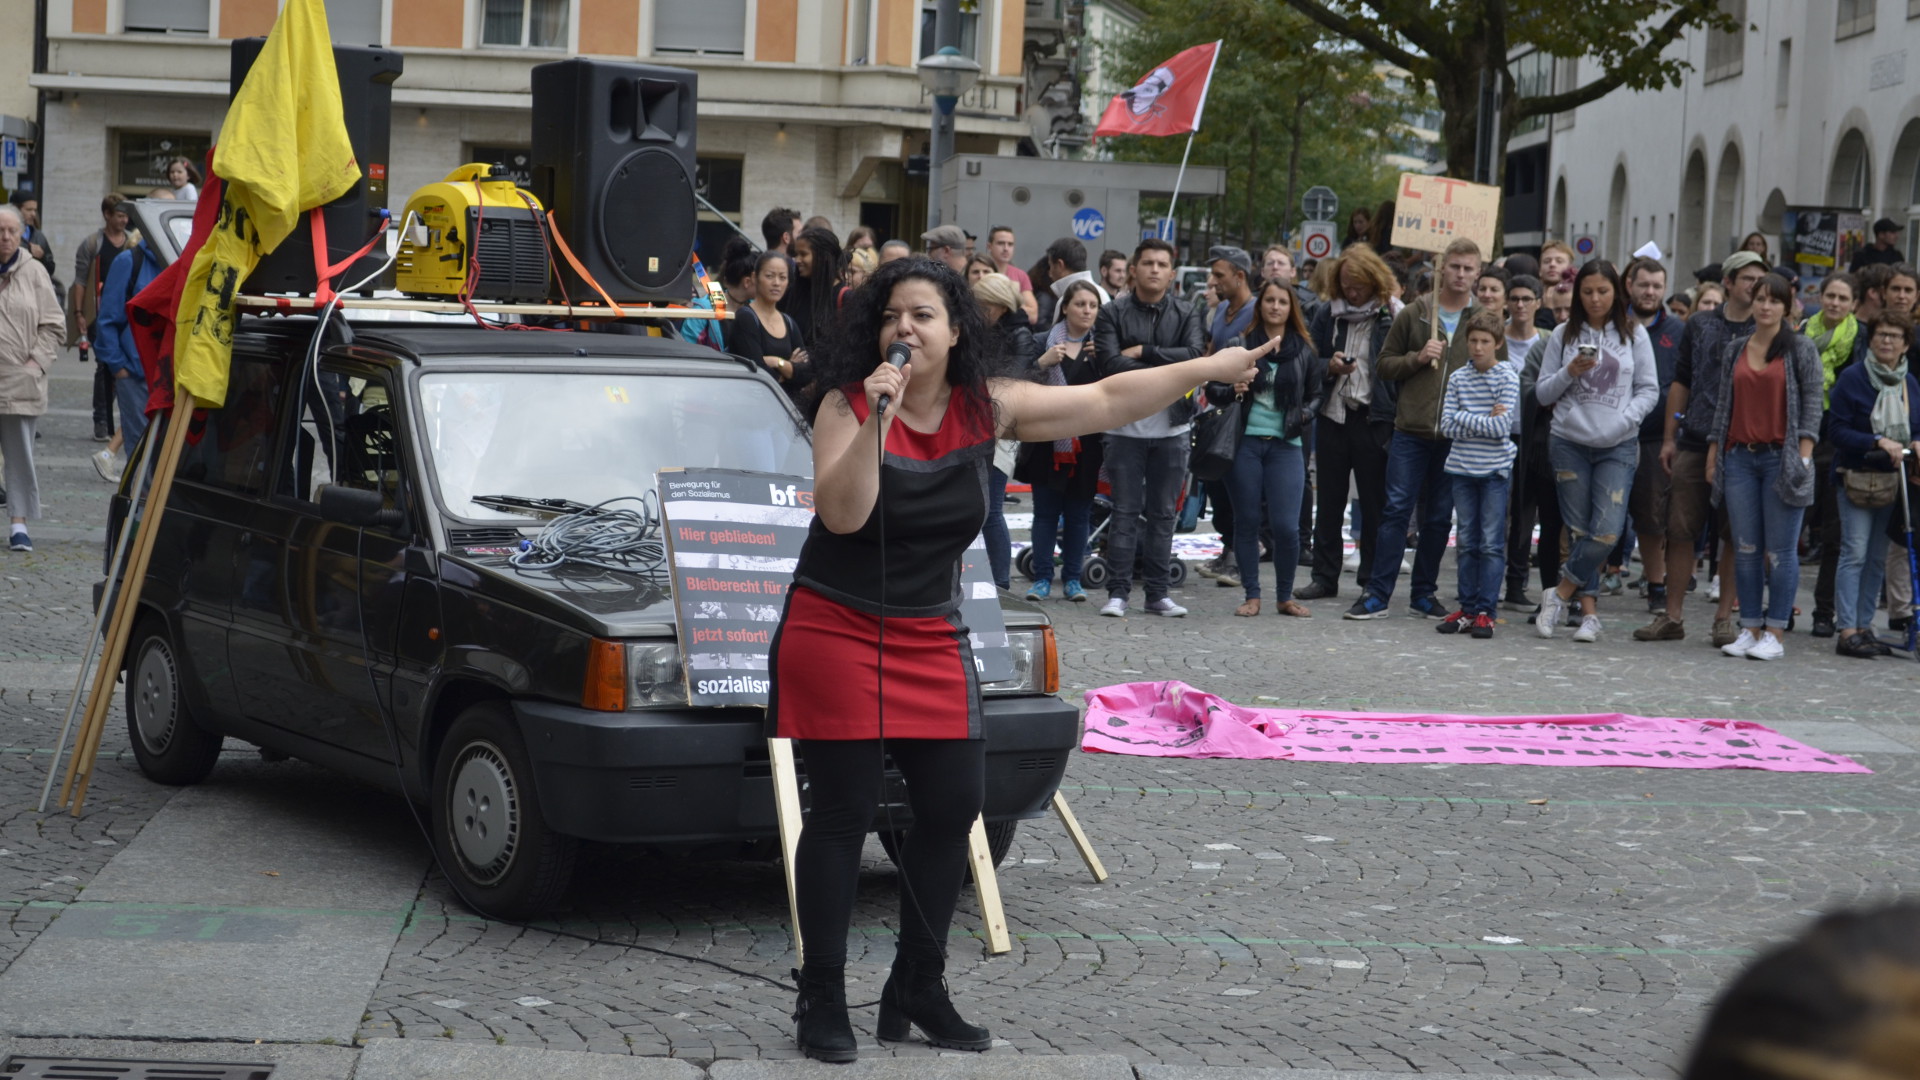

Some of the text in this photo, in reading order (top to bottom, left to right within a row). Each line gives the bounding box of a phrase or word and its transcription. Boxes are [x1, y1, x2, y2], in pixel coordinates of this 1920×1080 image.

[1424, 203, 1488, 228] THEM
[1072, 218, 1104, 237] WC
[669, 481, 721, 490] Bewegung für
[688, 490, 731, 499] Sozialismus
[679, 527, 777, 545] Hier geblieben!
[686, 577, 761, 594] Bleiberecht
[764, 580, 782, 595] für
[692, 628, 769, 644] jetzt sofort!
